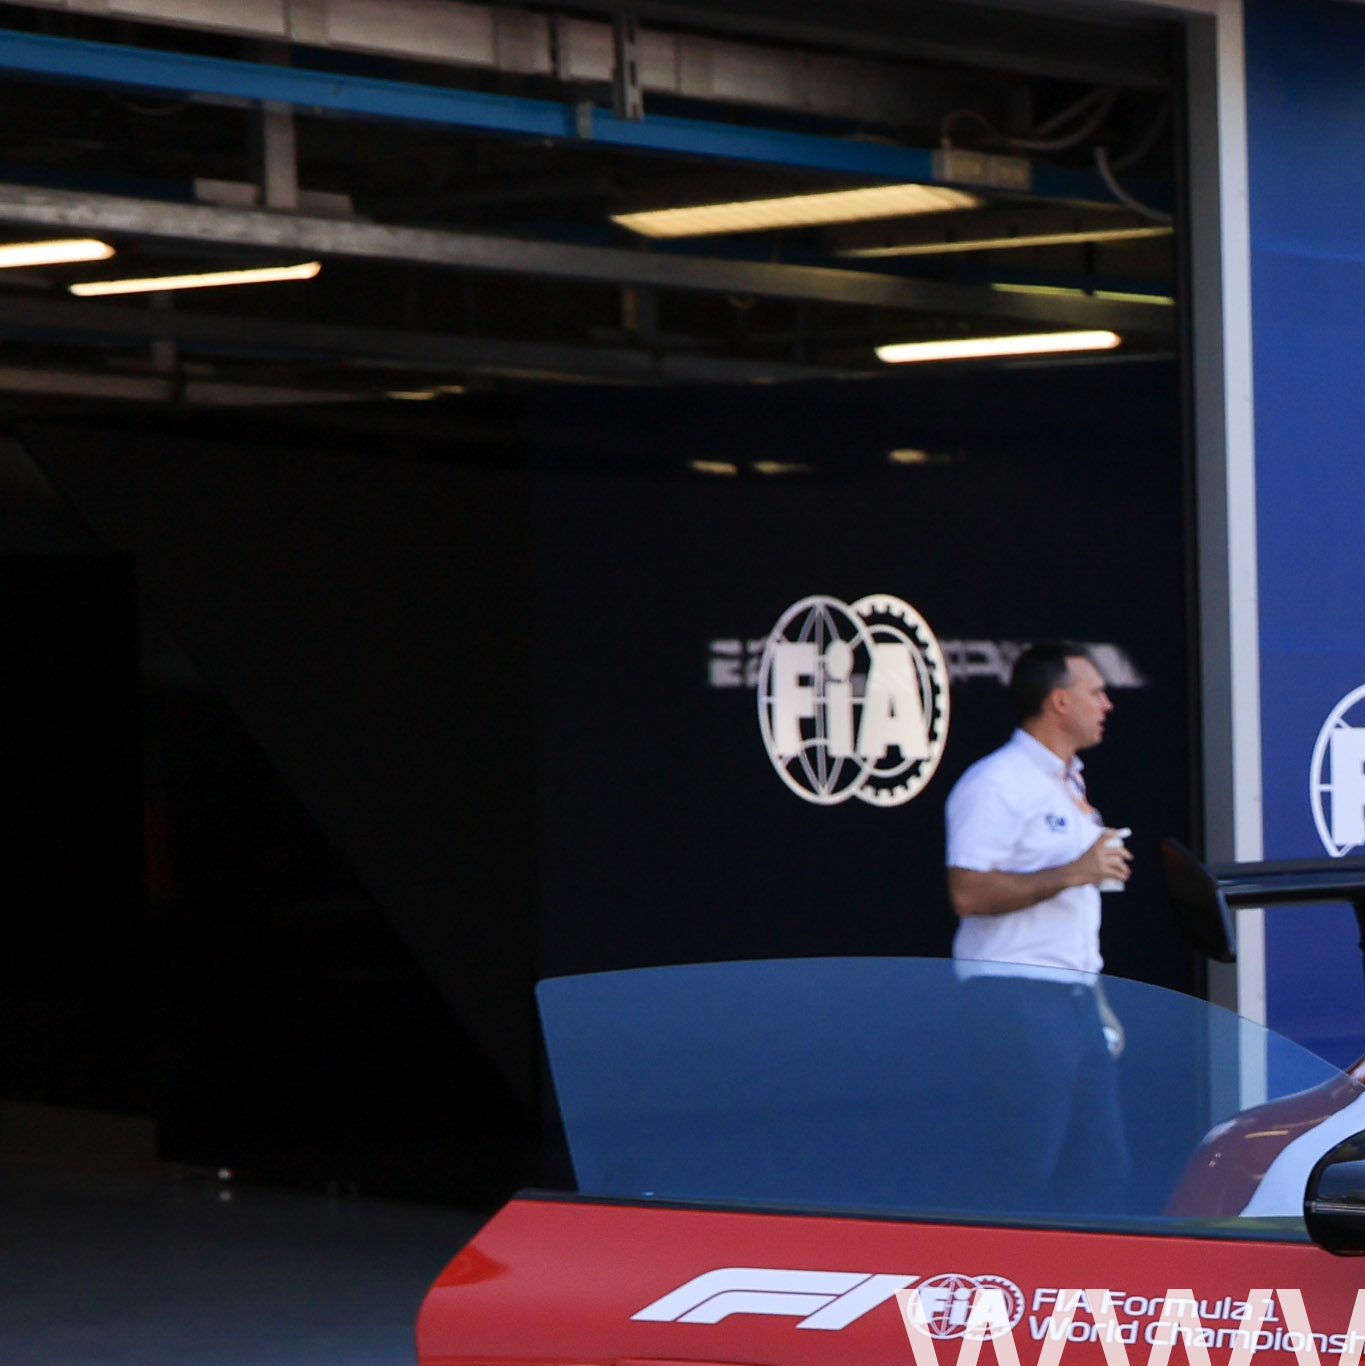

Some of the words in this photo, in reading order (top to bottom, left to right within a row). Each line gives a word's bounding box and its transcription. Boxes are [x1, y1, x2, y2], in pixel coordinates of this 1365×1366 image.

[630, 1267, 922, 1331] F1
[1031, 1287, 1094, 1313] FIA
[1100, 1291, 1249, 1322] Formula
[1256, 1298, 1279, 1323] 1
[1028, 1315, 1138, 1344] World
